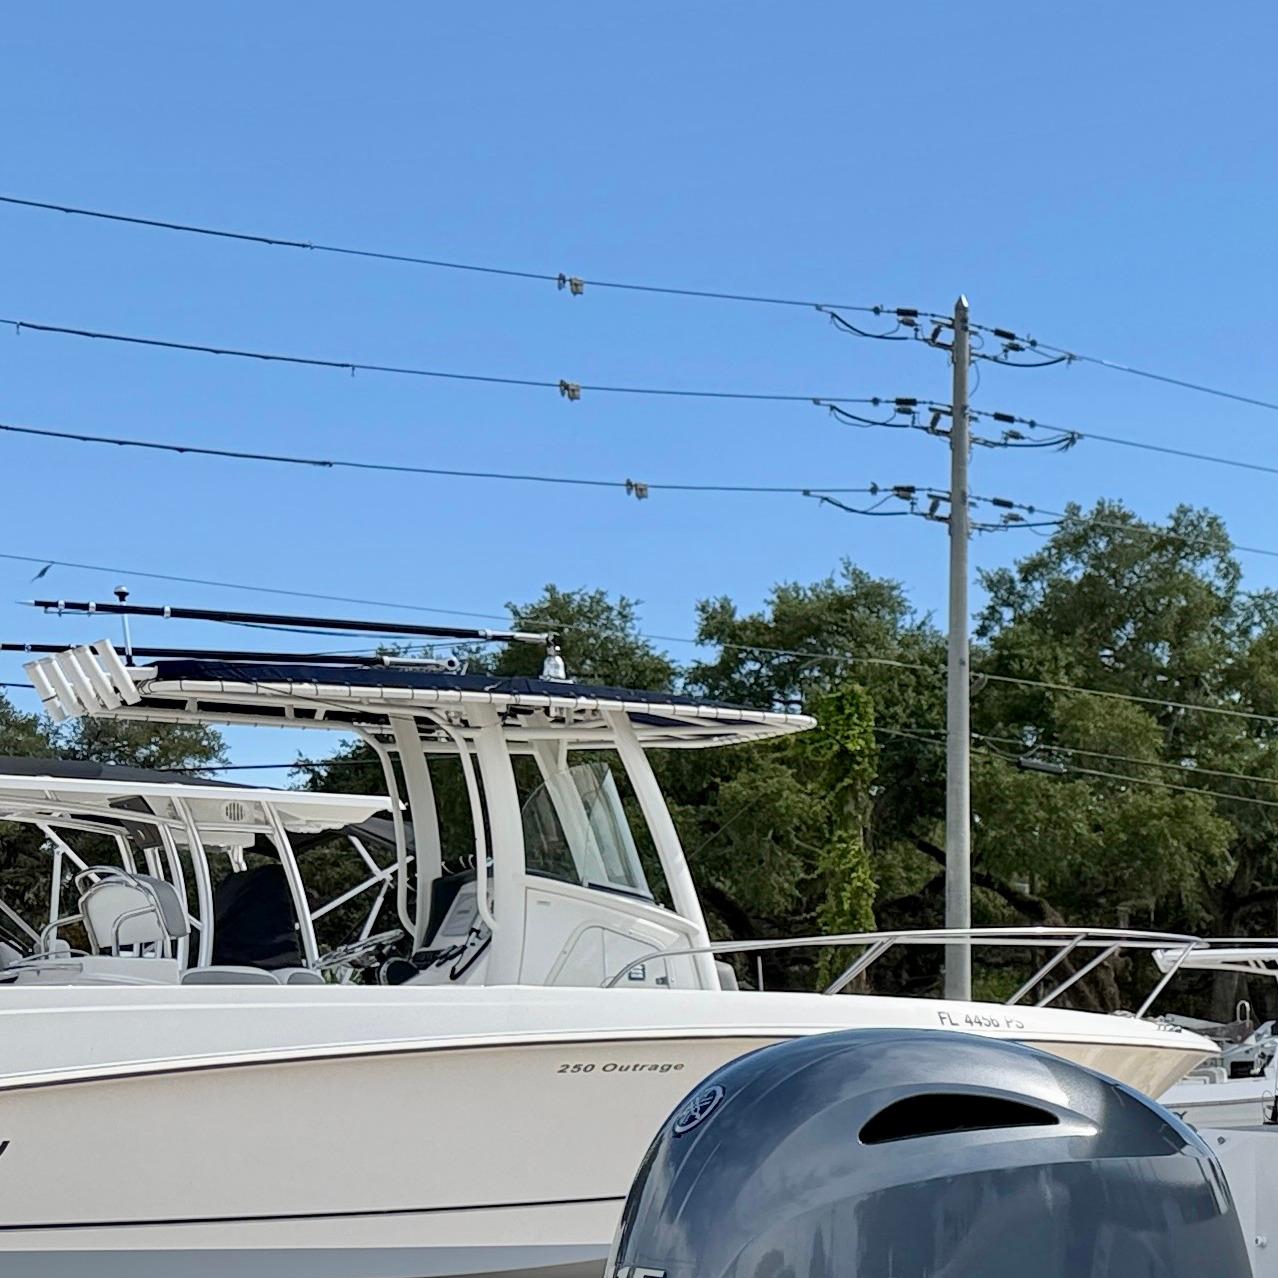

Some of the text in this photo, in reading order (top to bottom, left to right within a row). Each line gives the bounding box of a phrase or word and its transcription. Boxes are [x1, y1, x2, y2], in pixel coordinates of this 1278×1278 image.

[938, 1011, 959, 1026] FL
[557, 1062, 685, 1074] 250 Outrage
